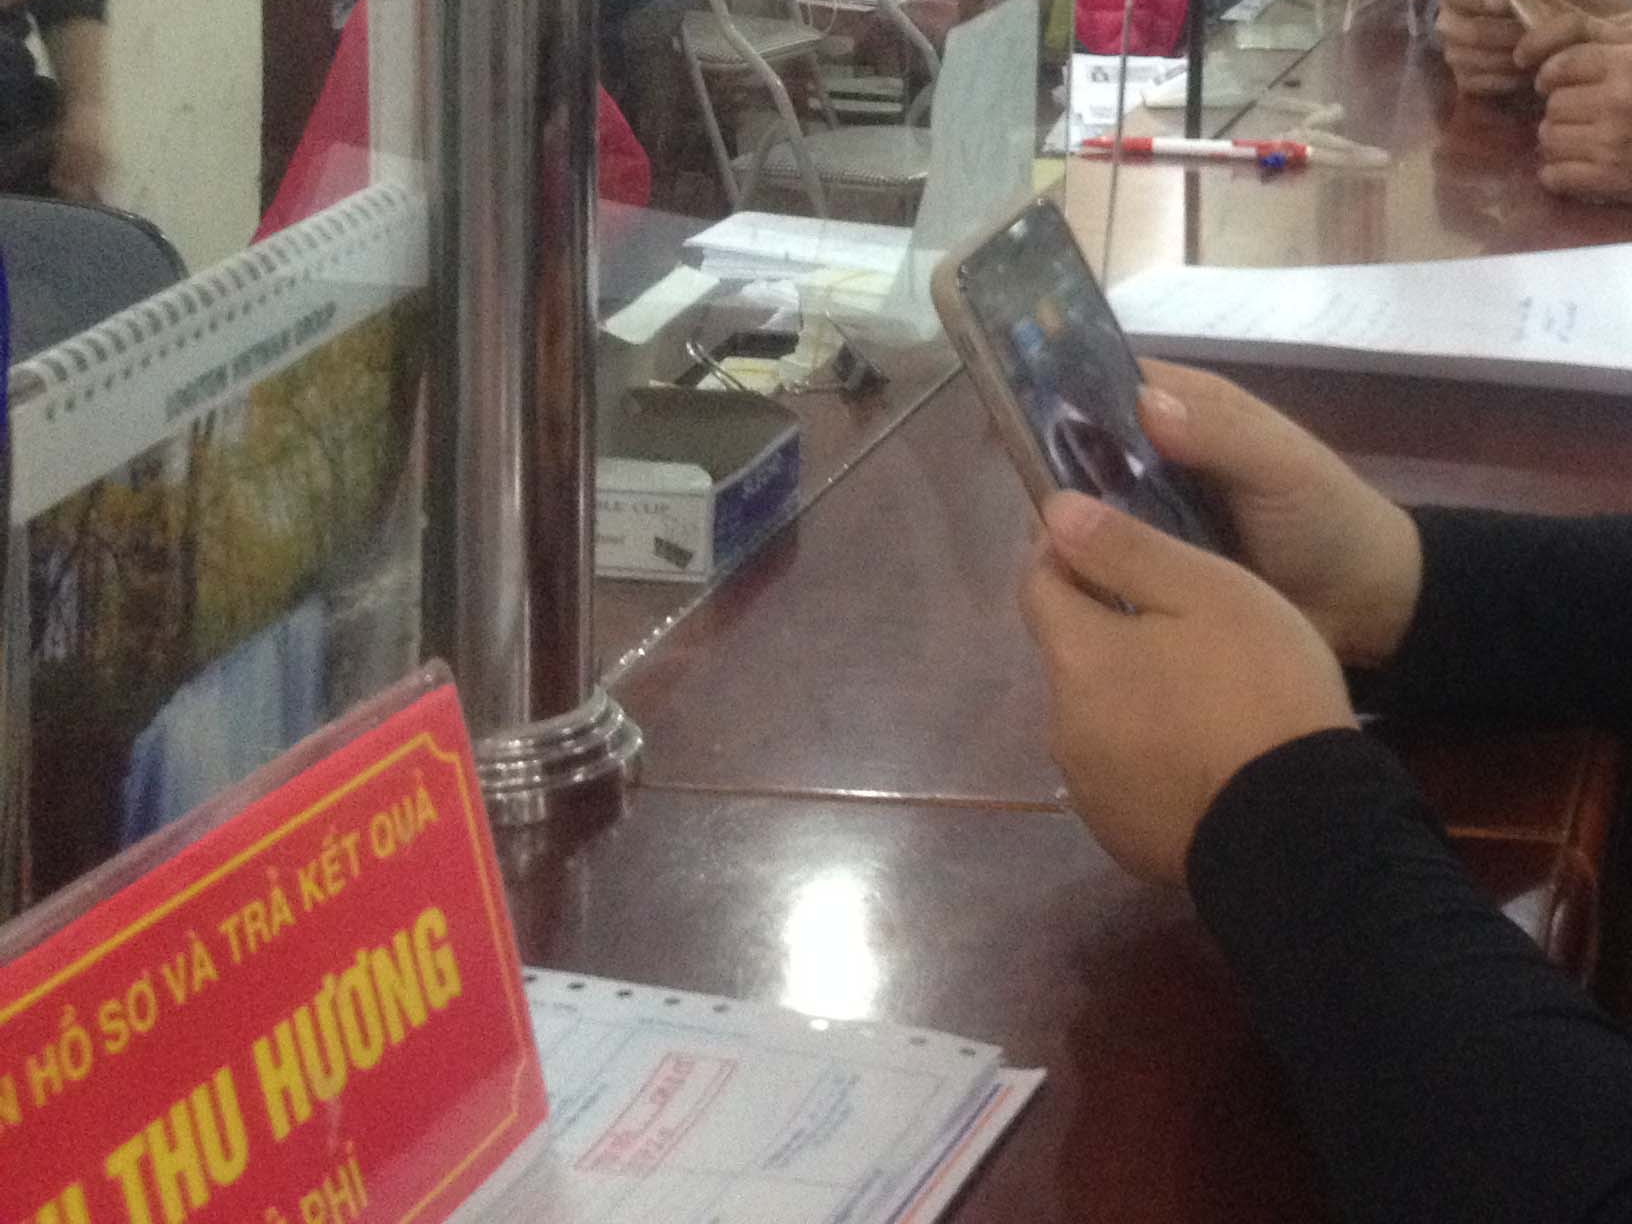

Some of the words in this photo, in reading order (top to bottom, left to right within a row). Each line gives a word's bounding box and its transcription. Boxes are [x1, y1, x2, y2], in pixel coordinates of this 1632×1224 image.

[161, 928, 220, 1006] VÀ
[218, 864, 297, 966] TRẢ
[105, 1066, 250, 1224] THU
[252, 907, 463, 1142] HƯƠNG
